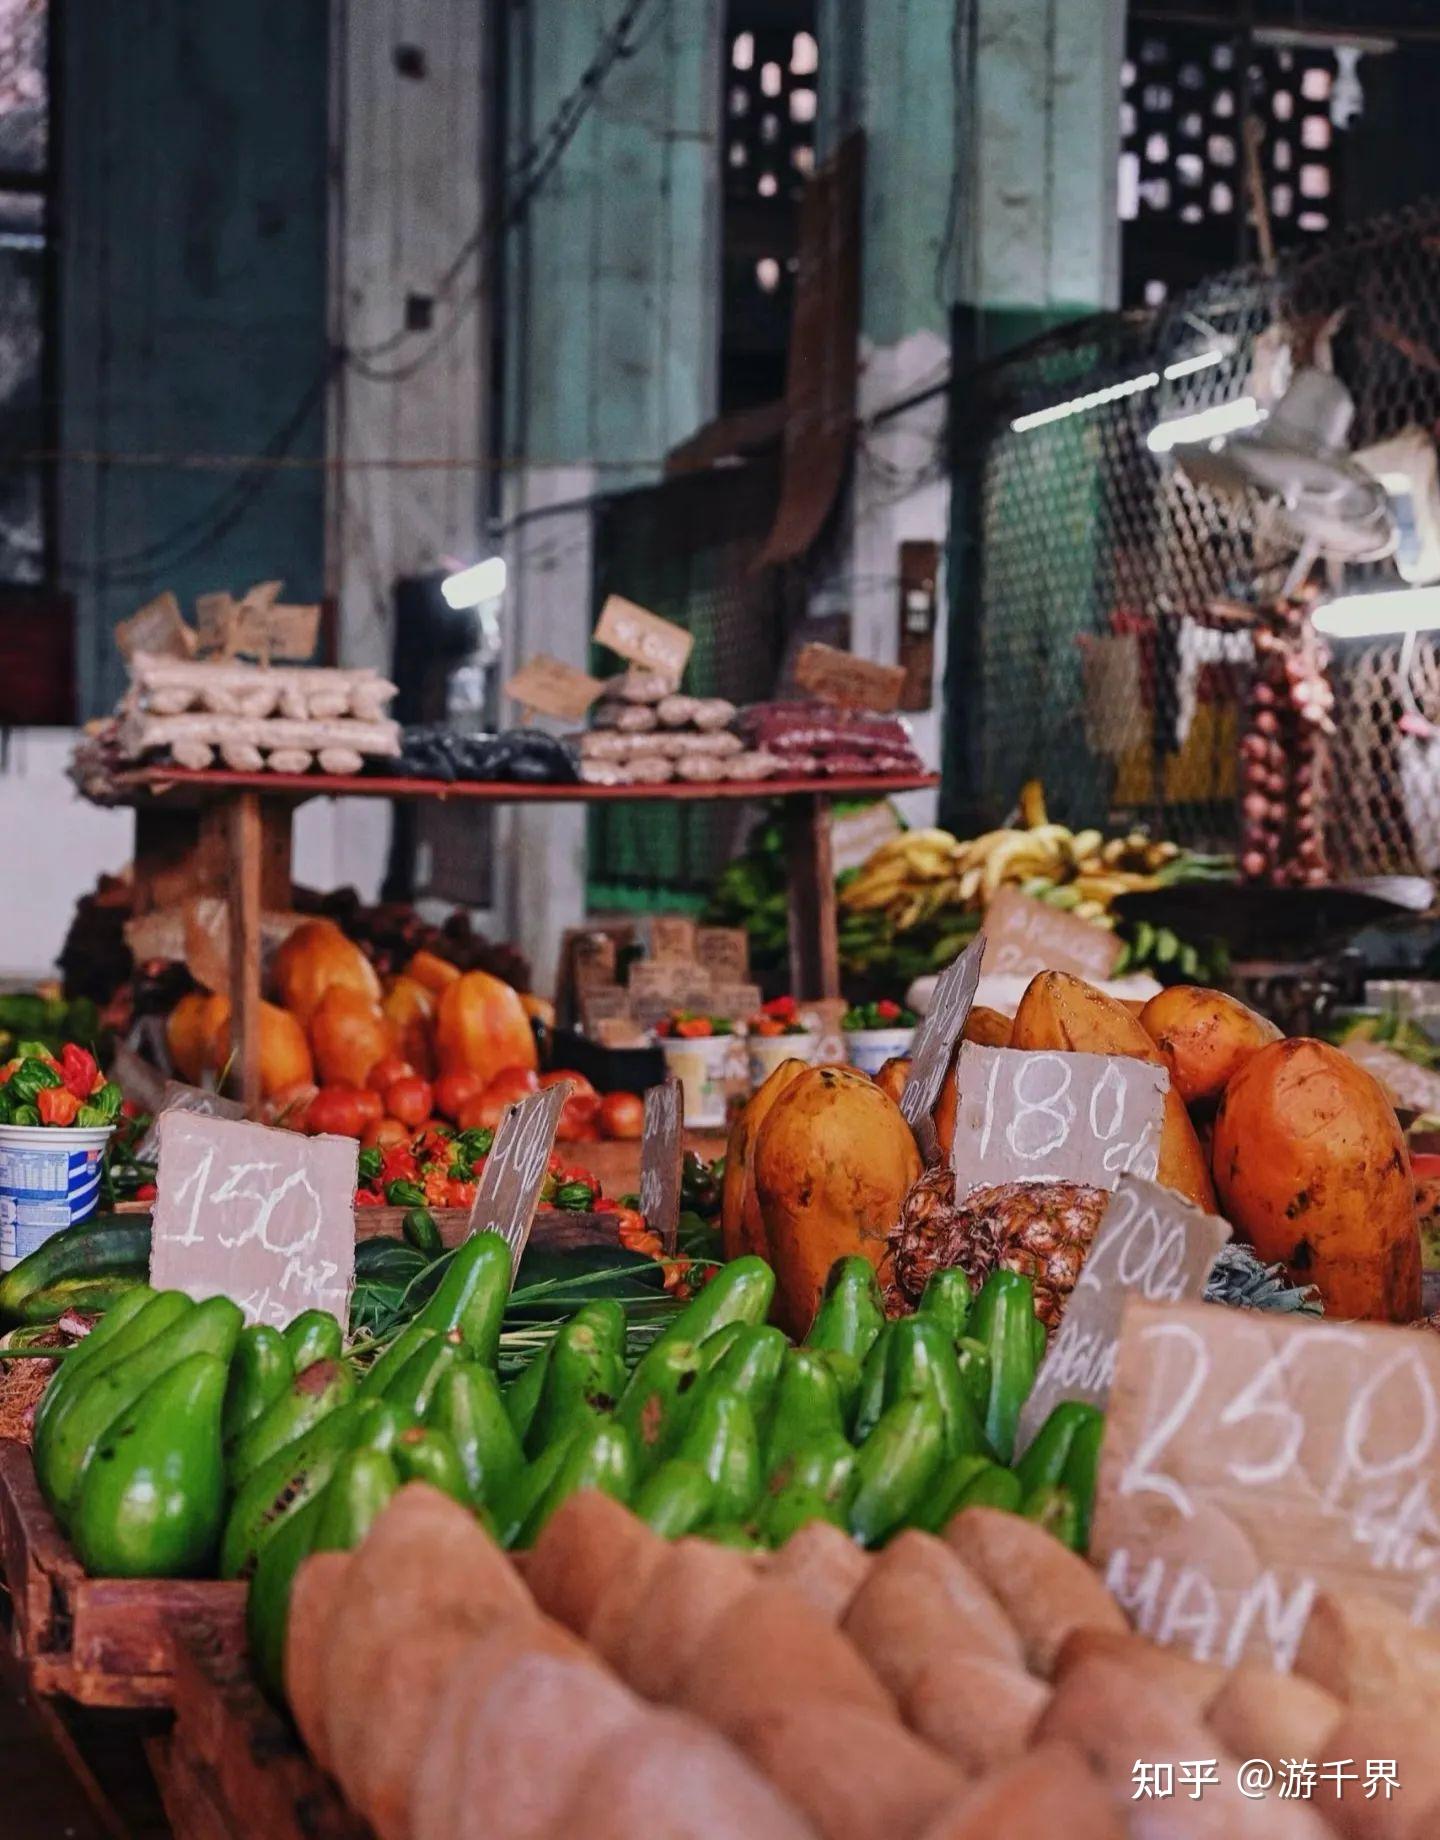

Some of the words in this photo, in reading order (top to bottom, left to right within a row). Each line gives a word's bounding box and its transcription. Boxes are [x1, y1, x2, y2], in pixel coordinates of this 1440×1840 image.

[979, 1054, 1128, 1160] 180
[161, 1149, 323, 1256] 150
[1120, 1324, 1440, 1517] 250
